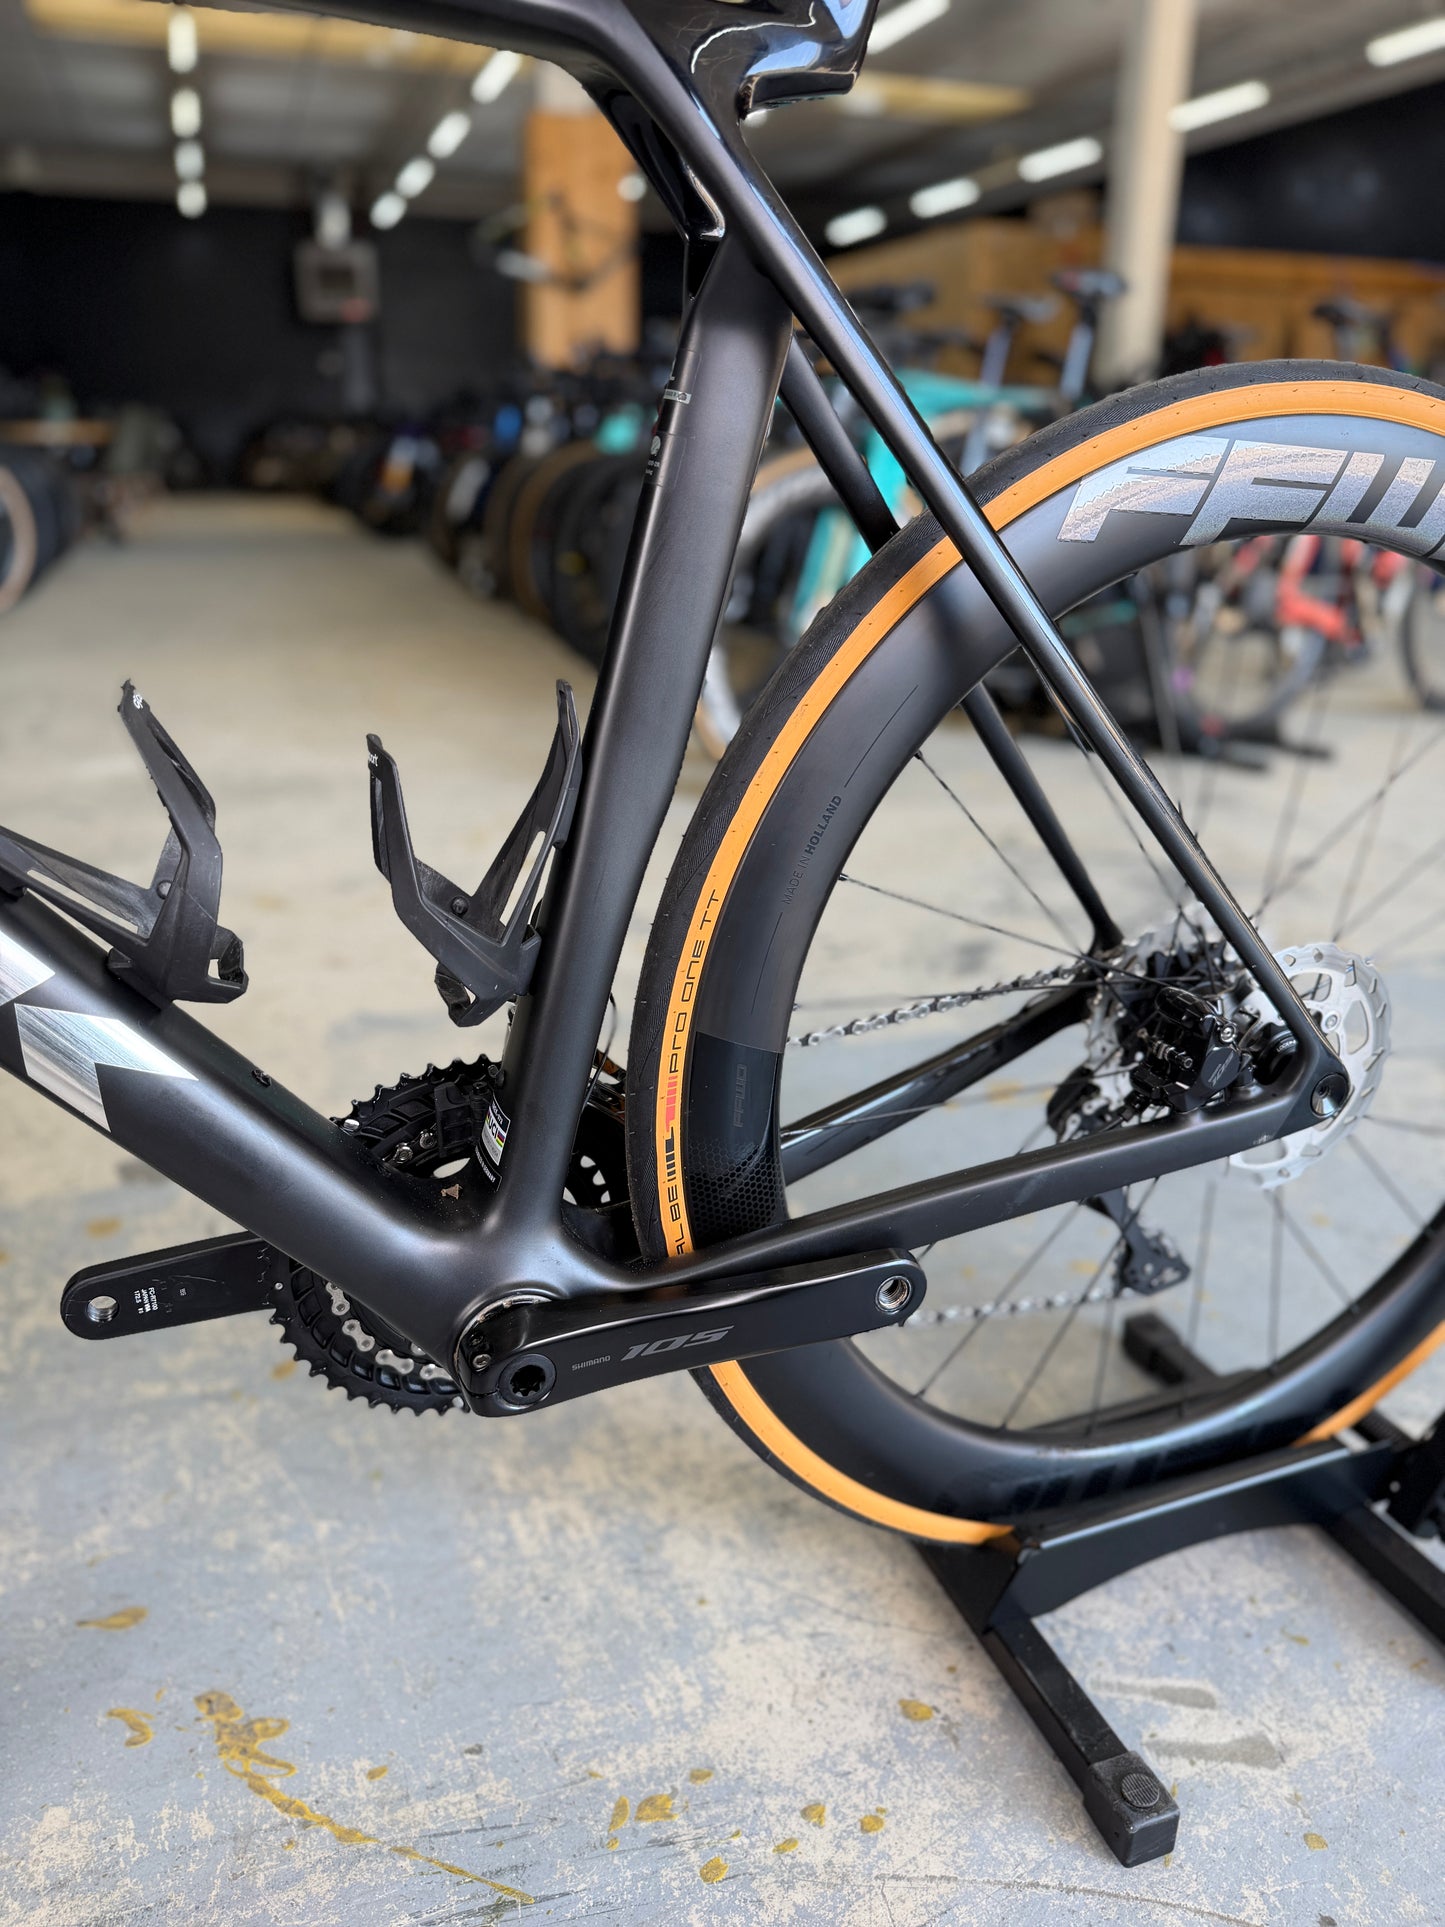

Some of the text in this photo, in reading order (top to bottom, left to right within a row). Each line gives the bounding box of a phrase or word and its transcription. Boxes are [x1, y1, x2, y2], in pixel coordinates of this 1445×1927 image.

[1056, 434, 1445, 562] FFW
[782, 795, 842, 905] MADE IN HOLLAND
[681, 939, 706, 1003] ONE
[700, 889, 719, 931] TT
[571, 1325, 735, 1371] SHIMANO 105
